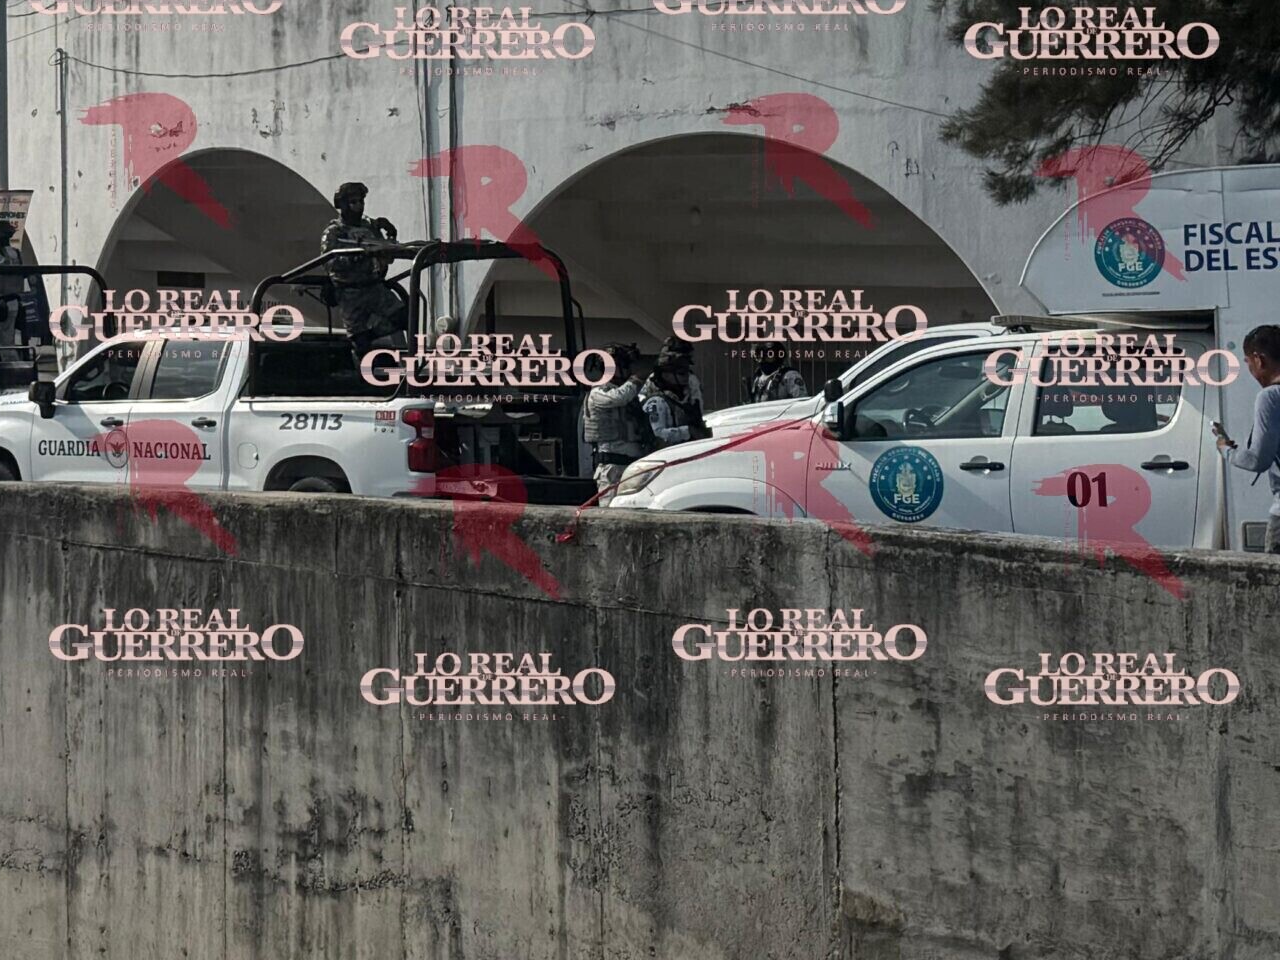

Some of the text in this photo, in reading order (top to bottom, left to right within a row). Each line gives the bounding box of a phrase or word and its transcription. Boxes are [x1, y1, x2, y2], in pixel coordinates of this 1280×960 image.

[1118, 262, 1143, 272] FGE
[1185, 247, 1280, 271] DEL ES
[279, 412, 343, 431] 28113
[38, 439, 211, 460] GUARDIA NACIONAL
[893, 493, 921, 504] FGE
[1066, 471, 1108, 508] 01
